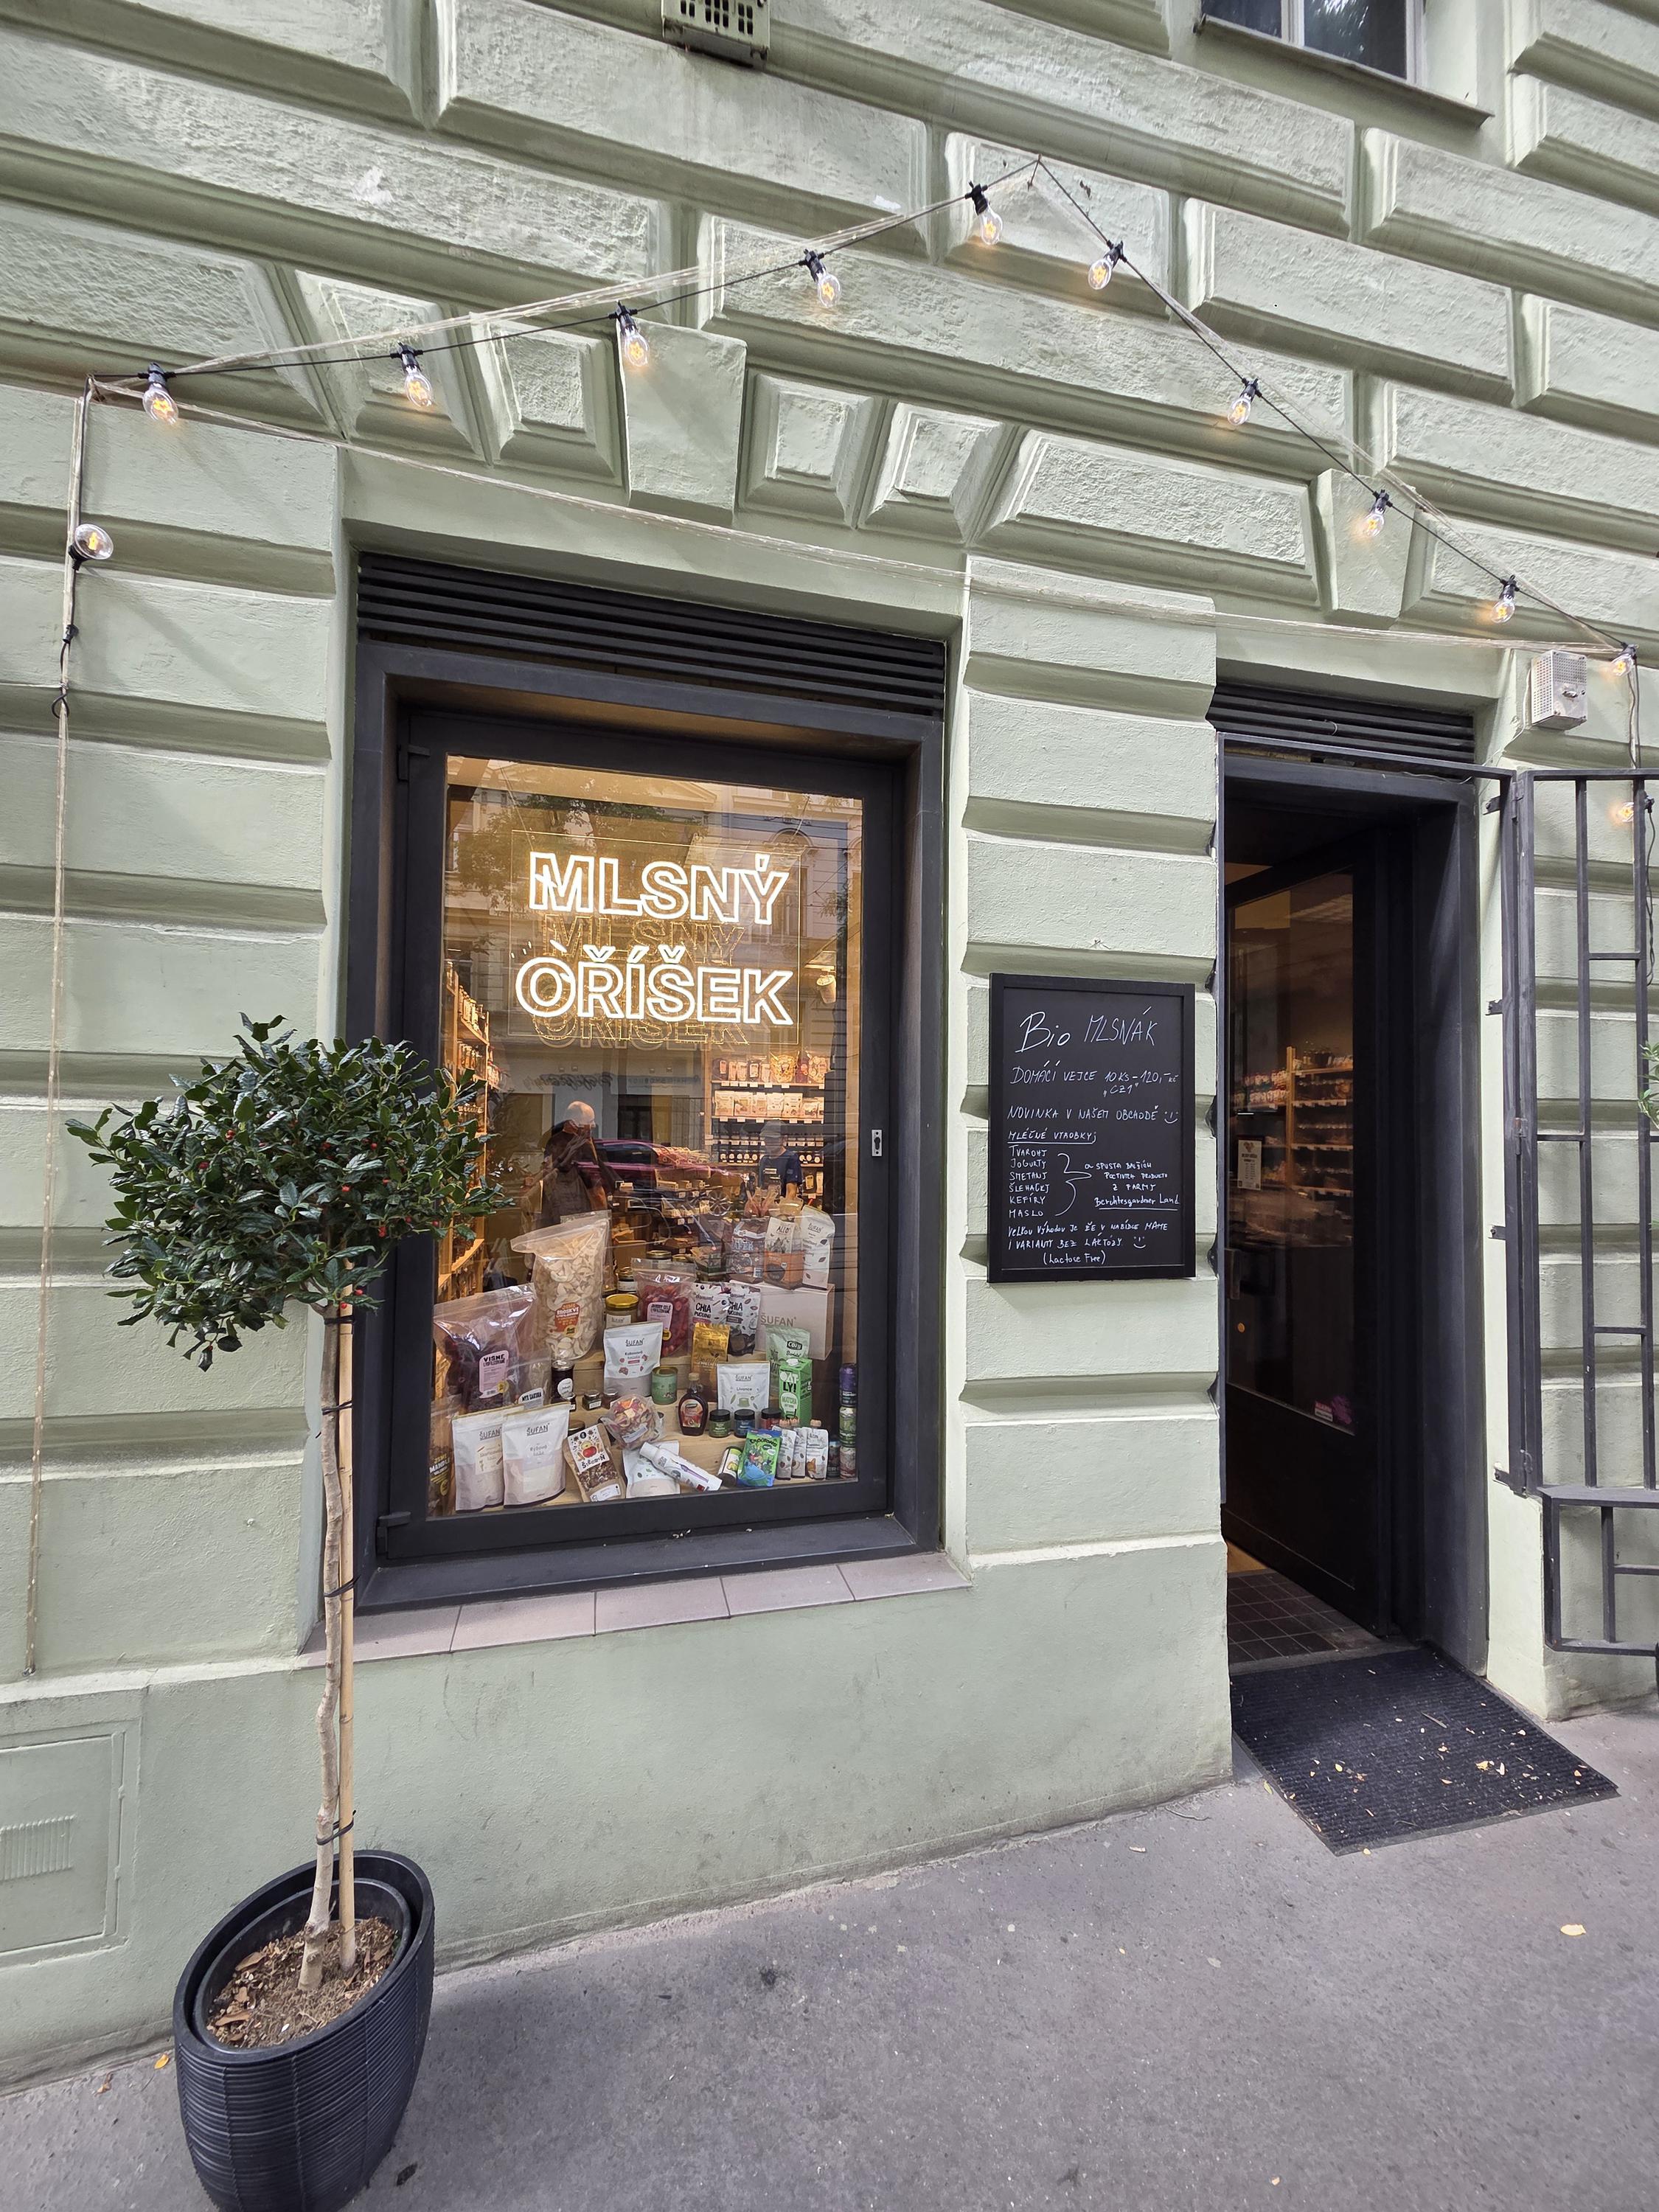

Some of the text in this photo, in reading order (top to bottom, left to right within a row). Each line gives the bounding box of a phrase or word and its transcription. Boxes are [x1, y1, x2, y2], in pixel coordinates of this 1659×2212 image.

[529, 851, 790, 925] MLSNÝ
[1015, 1006, 1158, 1052] Bio MLSNÁK
[1010, 1060, 1060, 1084] DOMÁCÍ
[1063, 1071, 1097, 1081] VEJCE
[1007, 1105, 1159, 1120] NOVINKA V NAŠEM OBCHODĚ
[1008, 1127, 1048, 1141] MLÉČNÉ
[1010, 1158, 1047, 1169] JOGURTY
[1009, 1192, 1046, 1205] KEFÍRY
[1159, 1193, 1180, 1205] Land
[1085, 1221, 1096, 1231] ŽE
[1057, 1239, 1077, 1249] BEZ
[695, 1302, 712, 1312] CHIA
[760, 1312, 793, 1326] ŠUFAN
